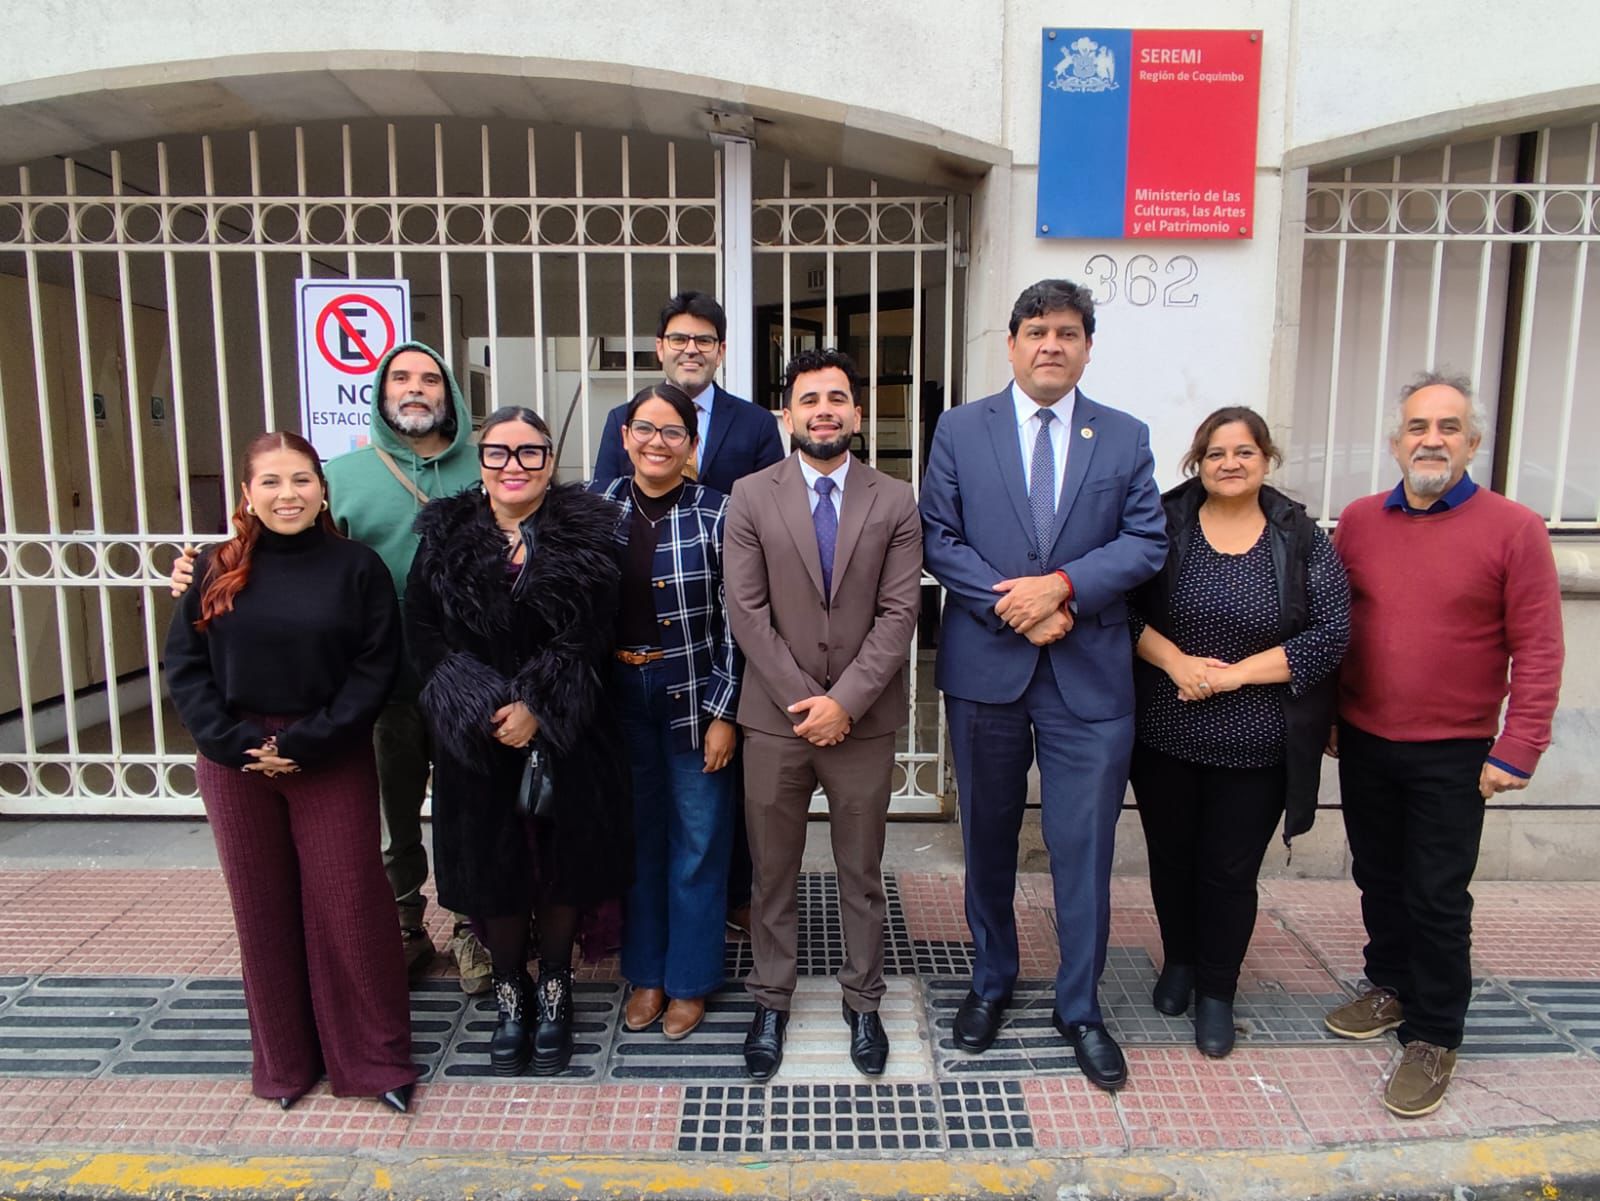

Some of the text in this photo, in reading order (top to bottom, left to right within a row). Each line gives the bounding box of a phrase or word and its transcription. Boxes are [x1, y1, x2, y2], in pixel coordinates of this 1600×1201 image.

[1140, 48, 1202, 64] SEREMI
[1139, 70, 1245, 83] Región de Coquimbo
[1135, 189, 1241, 202] Ministerio de las
[1134, 204, 1246, 218] Culturas, las Artes
[1133, 219, 1230, 234] y el Patrimonio
[1084, 254, 1199, 308] 362
[339, 308, 368, 360] E
[337, 384, 373, 405] NO
[312, 411, 371, 426] ESTACIO
